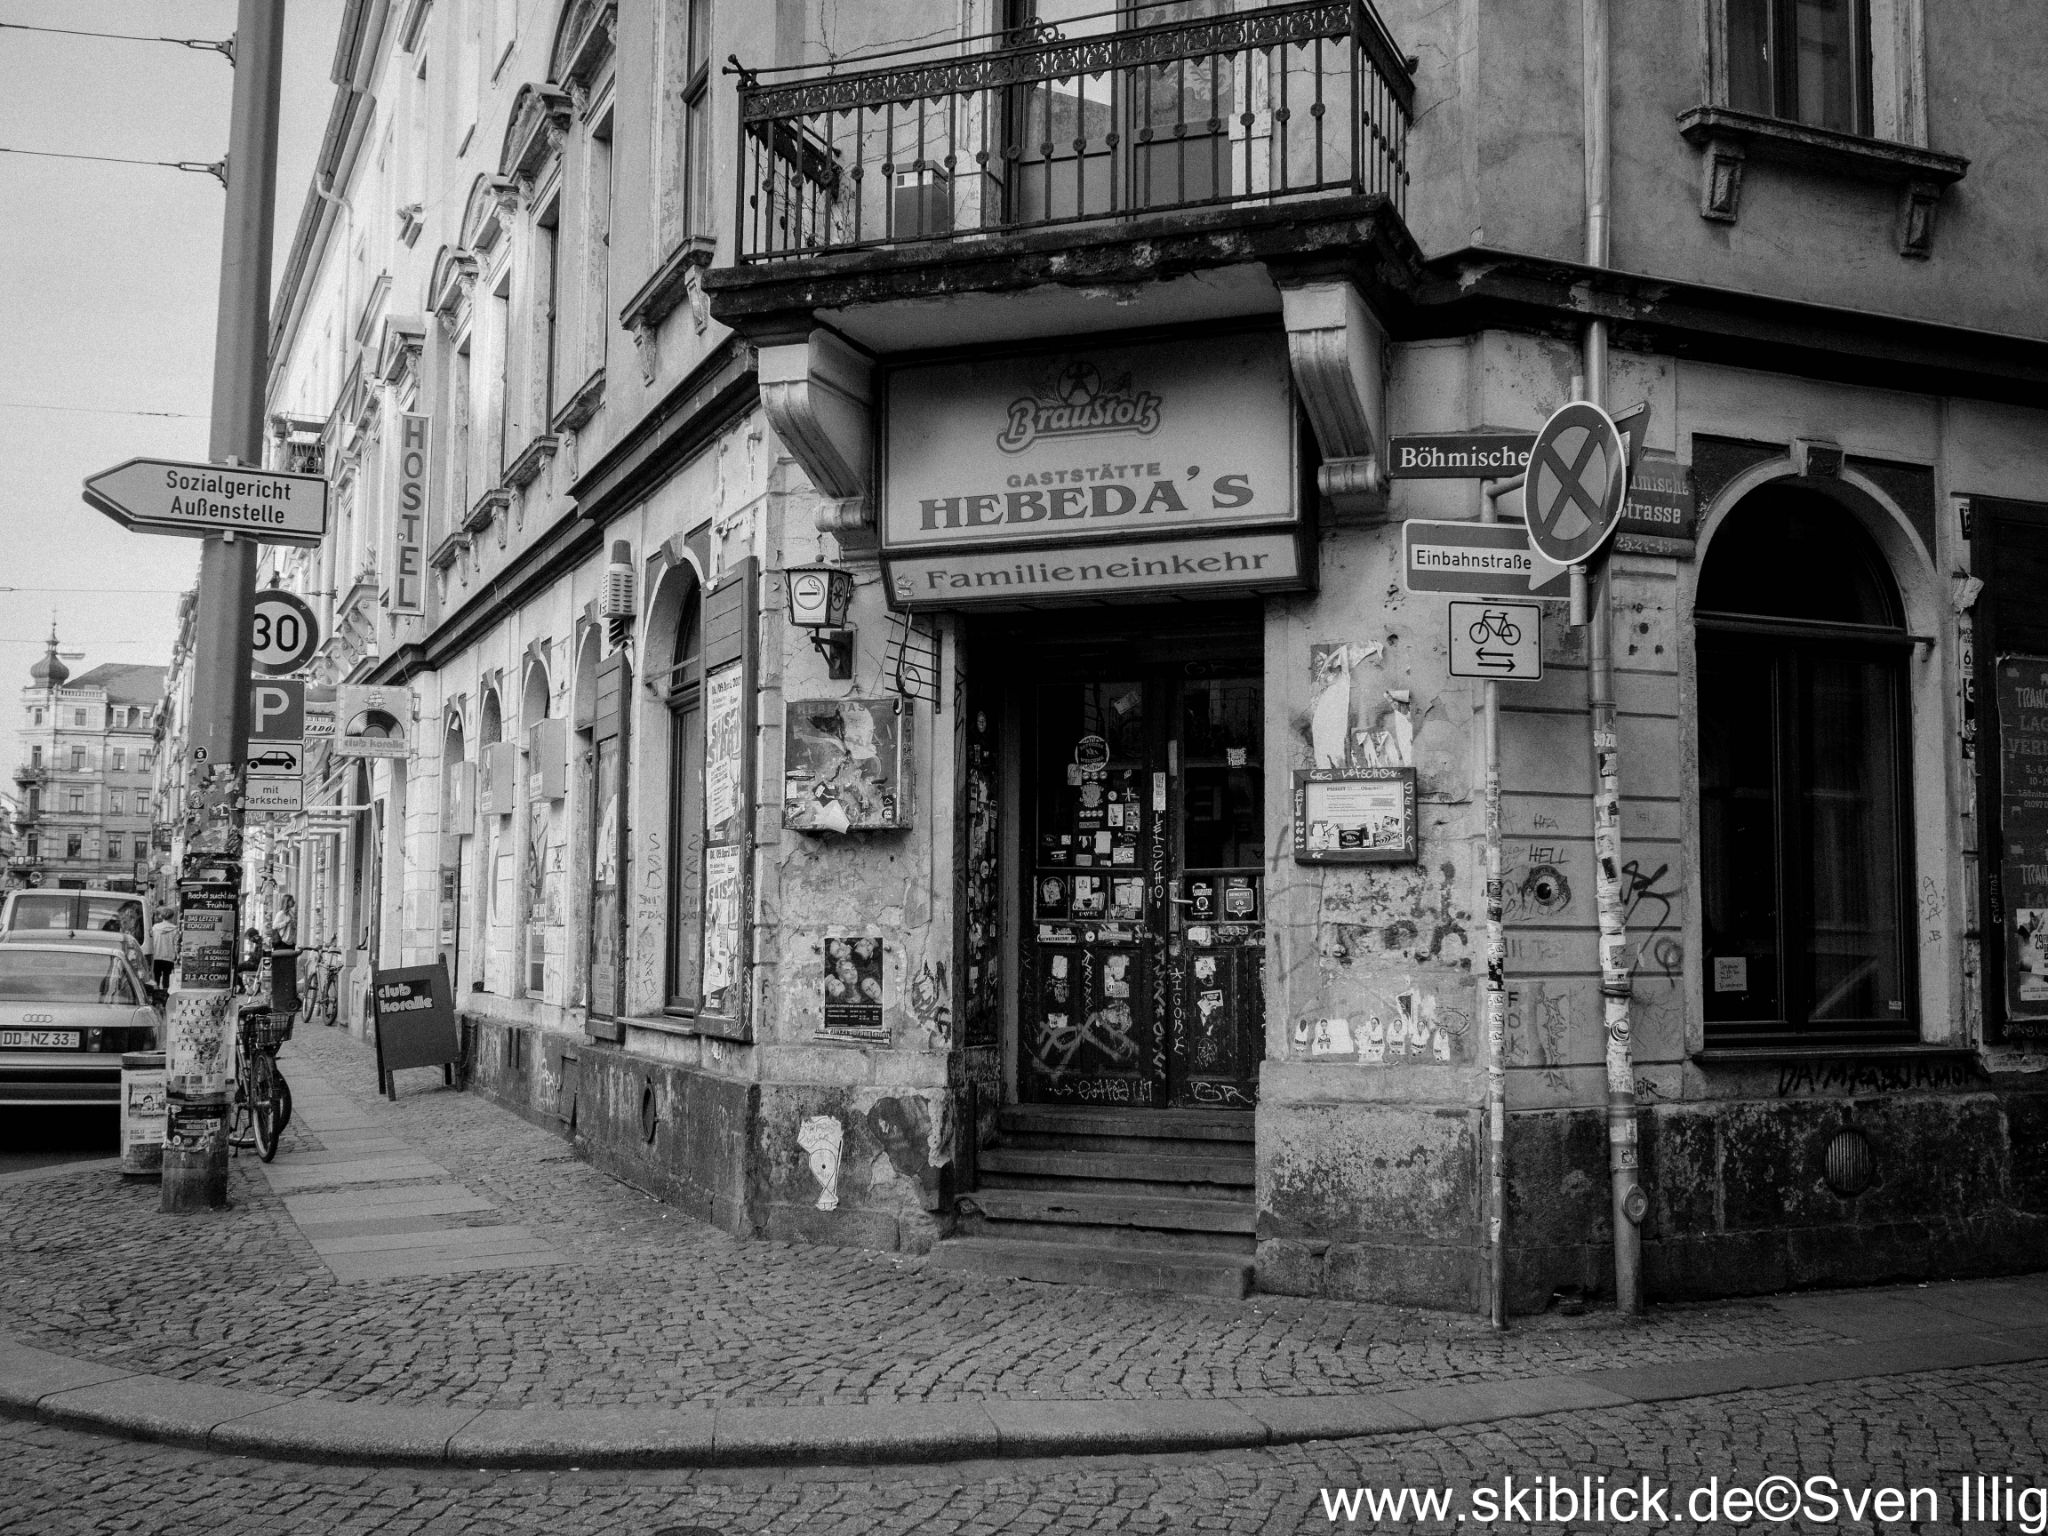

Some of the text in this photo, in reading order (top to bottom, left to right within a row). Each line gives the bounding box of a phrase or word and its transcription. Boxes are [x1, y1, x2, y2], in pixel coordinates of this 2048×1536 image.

[997, 388, 1164, 454] Braustolz
[1400, 445, 1530, 469] Böhmische
[166, 469, 292, 501] Sozialgericht
[1006, 462, 1161, 488] GASTSTÄTTE
[170, 495, 286, 524] Außenstelle
[398, 419, 425, 608] HOSTEL
[927, 549, 1270, 590] Familieneinkehr
[1416, 549, 1532, 570] Einbahnstraße
[253, 613, 300, 652] 30
[256, 686, 290, 733] P
[245, 795, 298, 805] Parkschein
[262, 785, 279, 794] mit
[378, 983, 412, 999] club
[379, 994, 433, 1014] koralle
[3, 1031, 22, 1045] DD
[31, 1032, 49, 1046] NZ
[52, 1033, 70, 1046] 33
